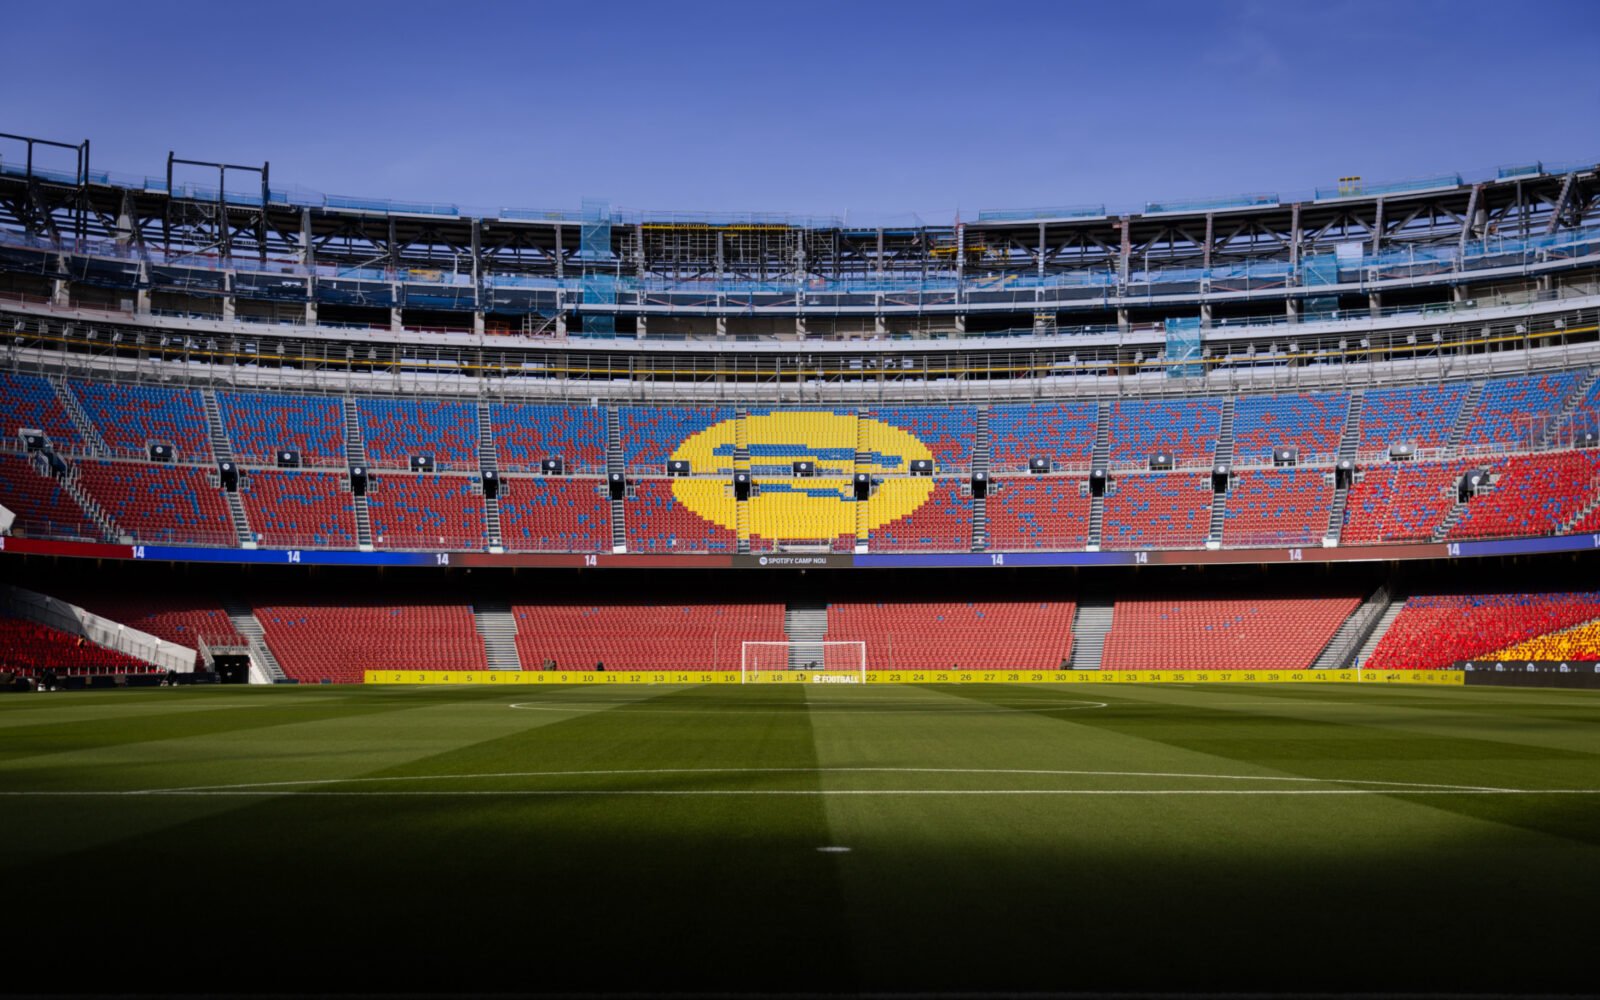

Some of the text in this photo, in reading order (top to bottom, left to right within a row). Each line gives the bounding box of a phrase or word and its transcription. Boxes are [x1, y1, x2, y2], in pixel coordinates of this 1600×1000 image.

[132, 545, 145, 558] 14
[287, 550, 301, 563] 14
[1289, 549, 1302, 562] 14
[1446, 544, 1460, 557] 14
[436, 552, 449, 565] 14
[584, 553, 597, 566] 14
[991, 553, 1004, 565] 14
[1134, 552, 1147, 565] 14
[583, 674, 594, 682] 10
[607, 674, 617, 682] 11
[630, 674, 641, 682] 12
[654, 674, 665, 682] 13
[677, 674, 688, 682] 14
[701, 674, 712, 682] 15
[725, 674, 736, 682] 16
[772, 674, 783, 682] 18
[865, 673, 877, 681] 22
[889, 673, 901, 681] 23
[913, 673, 925, 681] 24
[936, 673, 949, 681] 25
[960, 673, 972, 681] 26
[984, 673, 996, 681] 27
[1007, 673, 1019, 681] 28
[1031, 673, 1043, 681] 29
[1055, 673, 1067, 681] 30
[1078, 673, 1089, 681] 31
[1102, 673, 1113, 681] 32
[1126, 673, 1137, 681] 33
[1150, 673, 1161, 681] 34
[1173, 673, 1185, 681] 35
[1197, 673, 1208, 681] 36
[1221, 673, 1232, 681] 37
[1244, 673, 1256, 681] 38
[1269, 673, 1279, 681] 39
[1291, 673, 1303, 681] 40
[1315, 673, 1327, 681] 41
[1340, 673, 1352, 681] 42
[1364, 673, 1376, 681] 43
